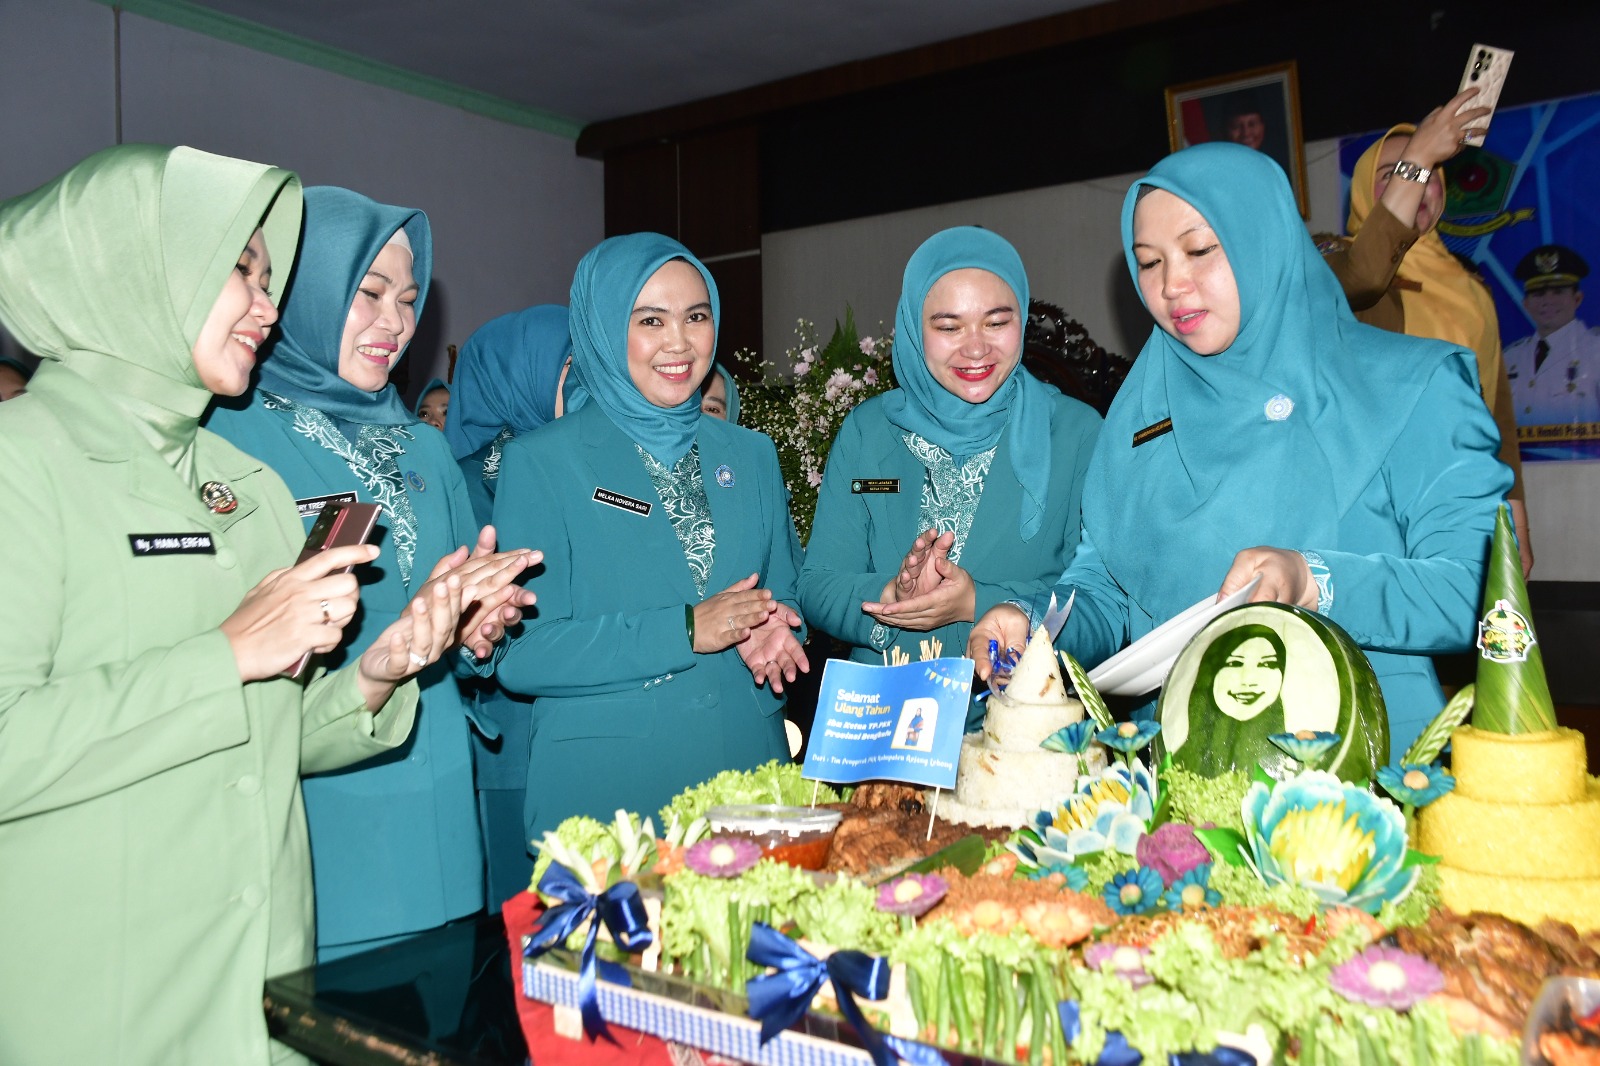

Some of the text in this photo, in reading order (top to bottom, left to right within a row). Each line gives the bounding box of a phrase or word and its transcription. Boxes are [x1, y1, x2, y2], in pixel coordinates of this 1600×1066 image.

[597, 492, 614, 501] MELKA
[636, 503, 648, 511] SARI
[154, 537, 181, 550] HANA
[836, 688, 880, 704] Selamat
[834, 701, 891, 718] Ulang Tahun
[843, 721, 867, 730] Ketua
[824, 729, 892, 741] Provinsi Bengkulu
[812, 754, 825, 762] Dari
[831, 756, 841, 764] Tim
[905, 754, 929, 767] Rejang
[930, 758, 953, 771] Lebong
